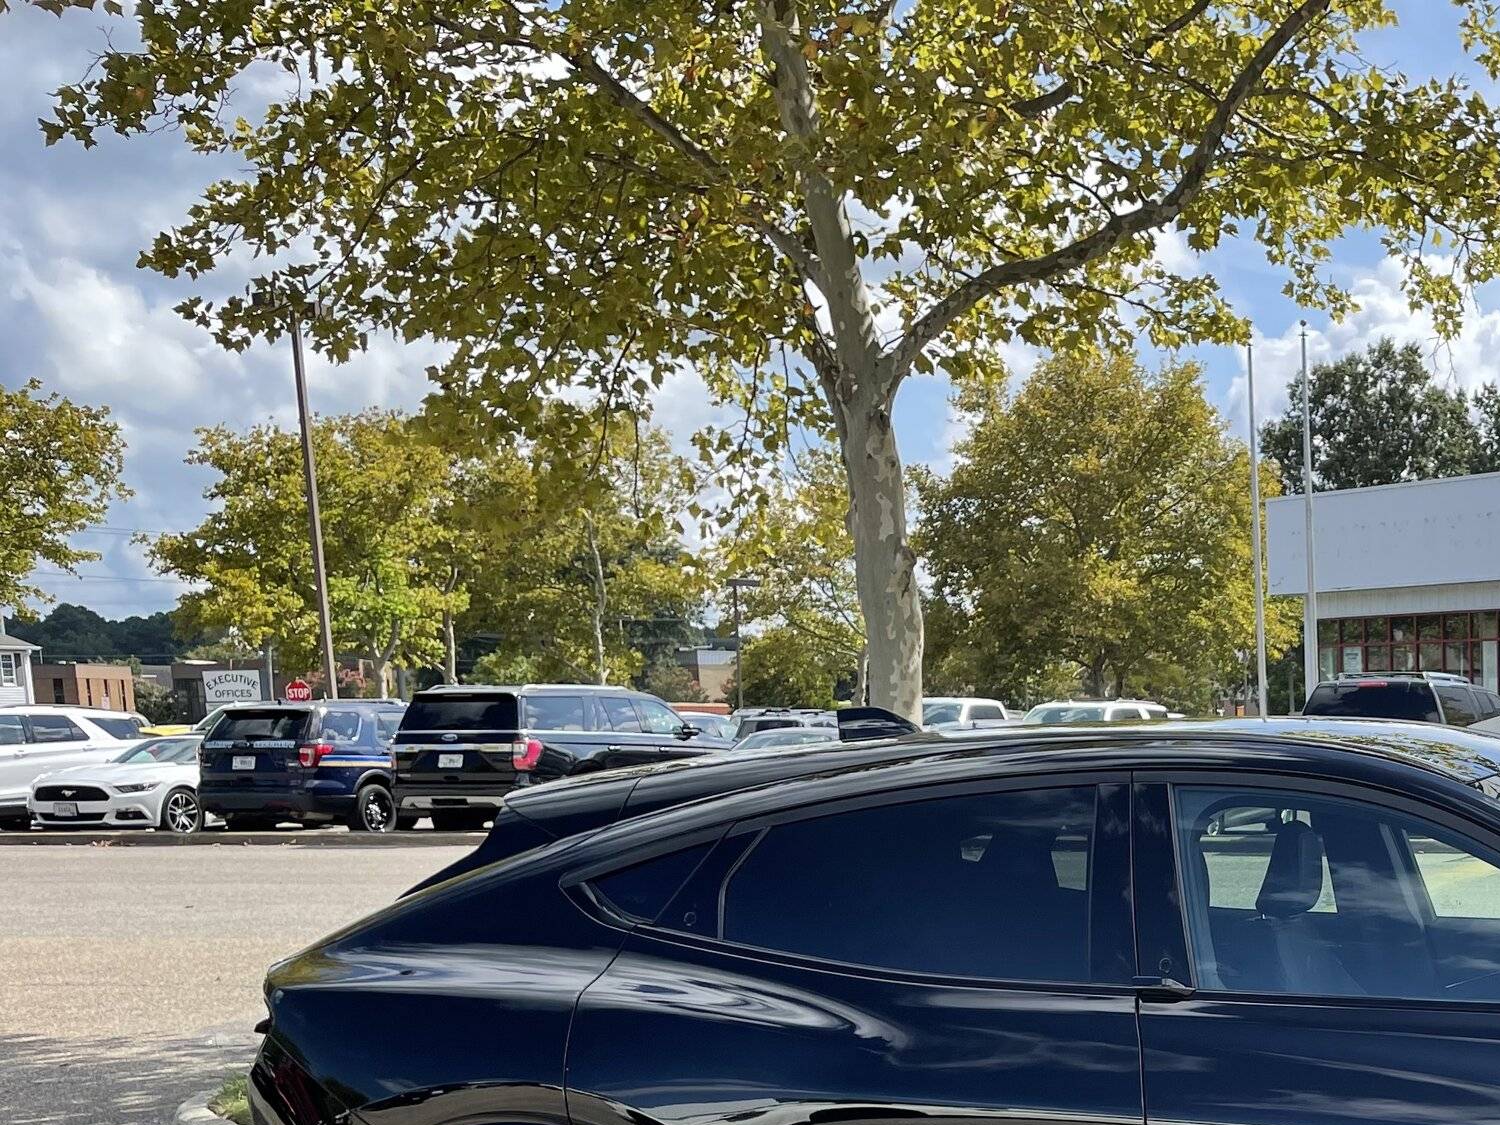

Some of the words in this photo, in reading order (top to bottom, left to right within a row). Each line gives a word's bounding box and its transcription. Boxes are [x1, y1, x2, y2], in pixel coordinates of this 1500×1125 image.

[205, 673, 259, 691] EXECUTIVE
[214, 689, 252, 698] OFFICES
[288, 688, 309, 699] STOP
